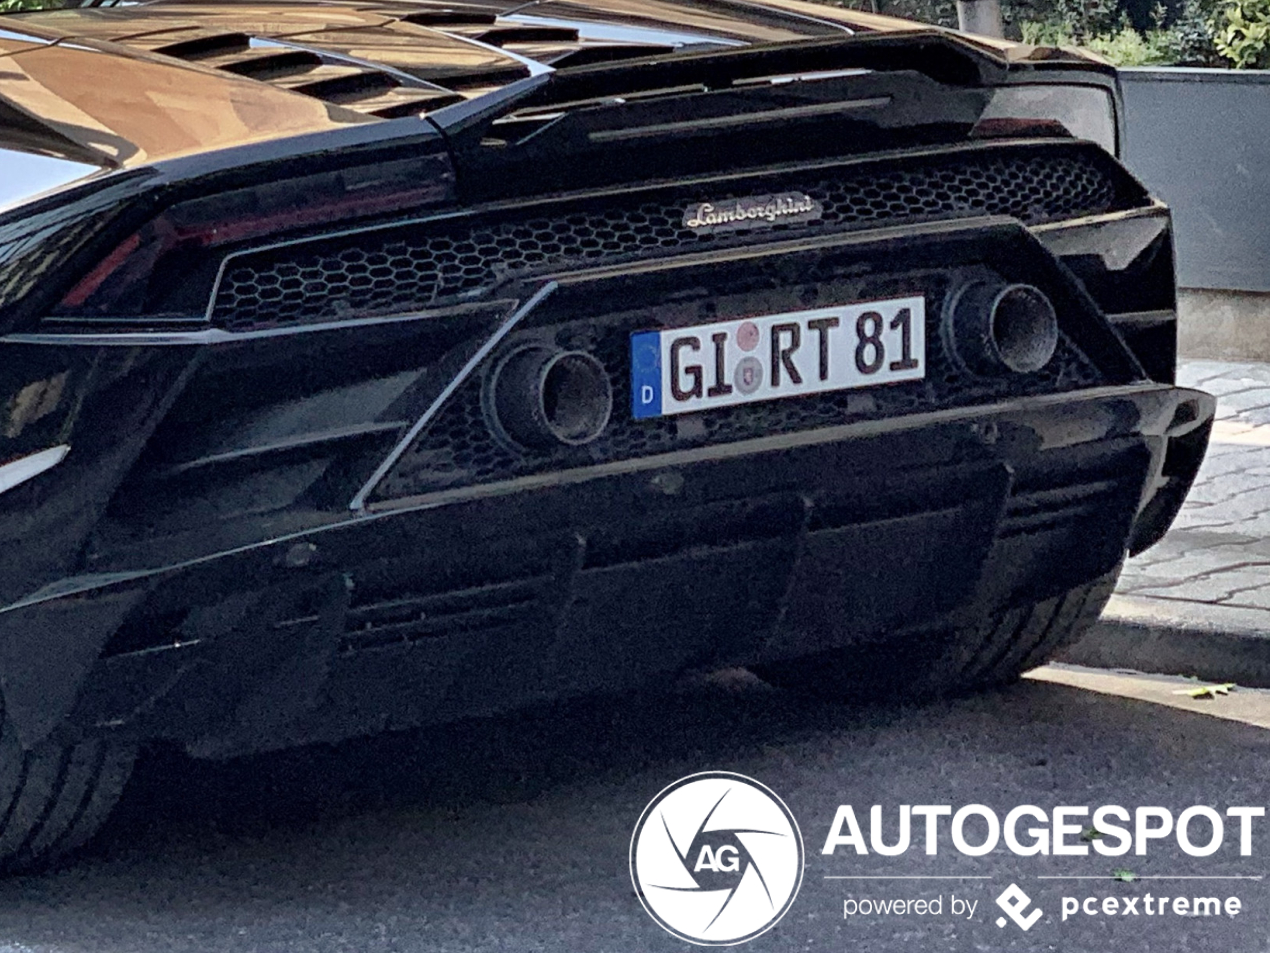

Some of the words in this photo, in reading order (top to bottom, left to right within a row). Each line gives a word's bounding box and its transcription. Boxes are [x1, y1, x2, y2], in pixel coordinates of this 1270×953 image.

[687, 194, 816, 227] Lamborghini
[670, 332, 733, 402] GI
[771, 307, 840, 388] RT
[855, 307, 920, 375] 81
[641, 385, 654, 404] D
